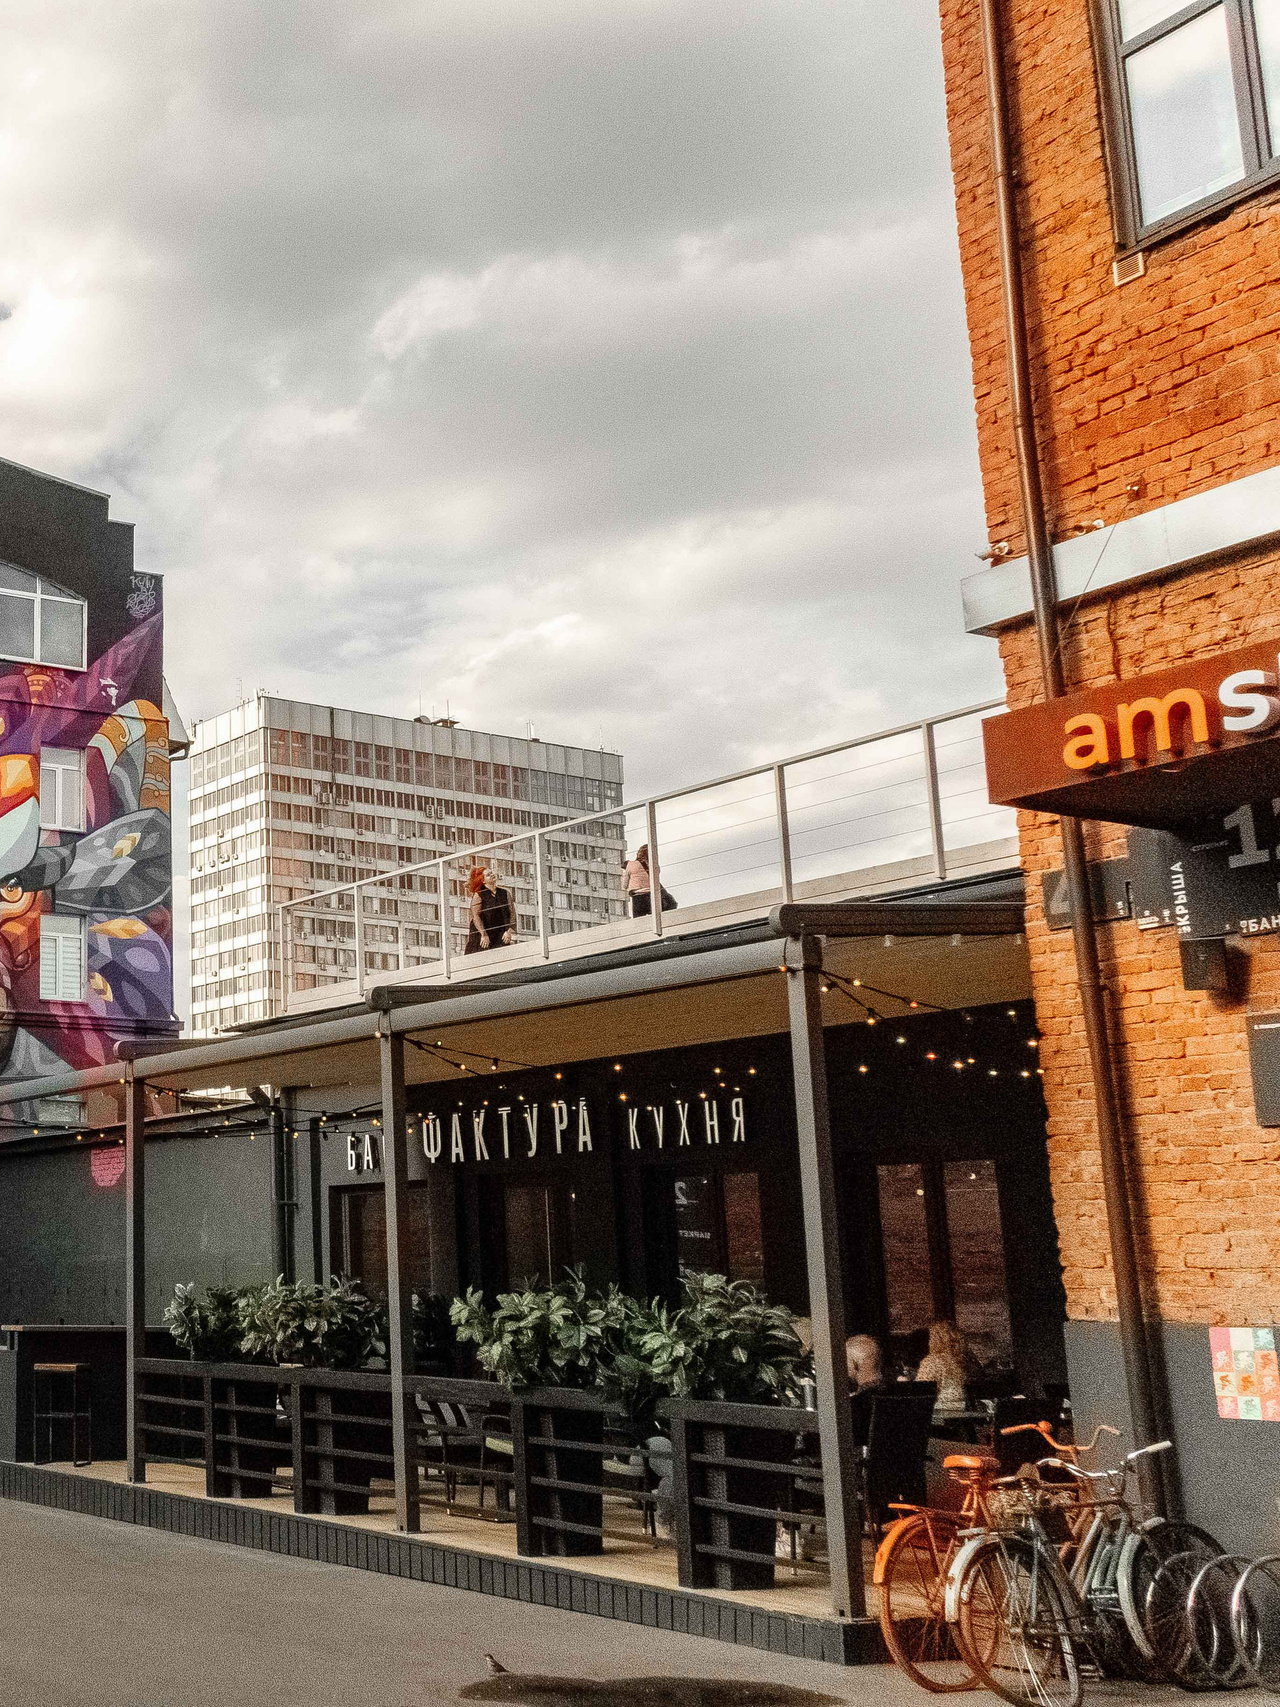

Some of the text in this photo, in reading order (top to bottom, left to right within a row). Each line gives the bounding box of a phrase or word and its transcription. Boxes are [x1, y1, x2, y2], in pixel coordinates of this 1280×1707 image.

[1062, 652, 1280, 770] ams
[1170, 861, 1190, 928] КРЫША
[347, 1097, 745, 1171] БА ФАКТУРА КУХНЯ
